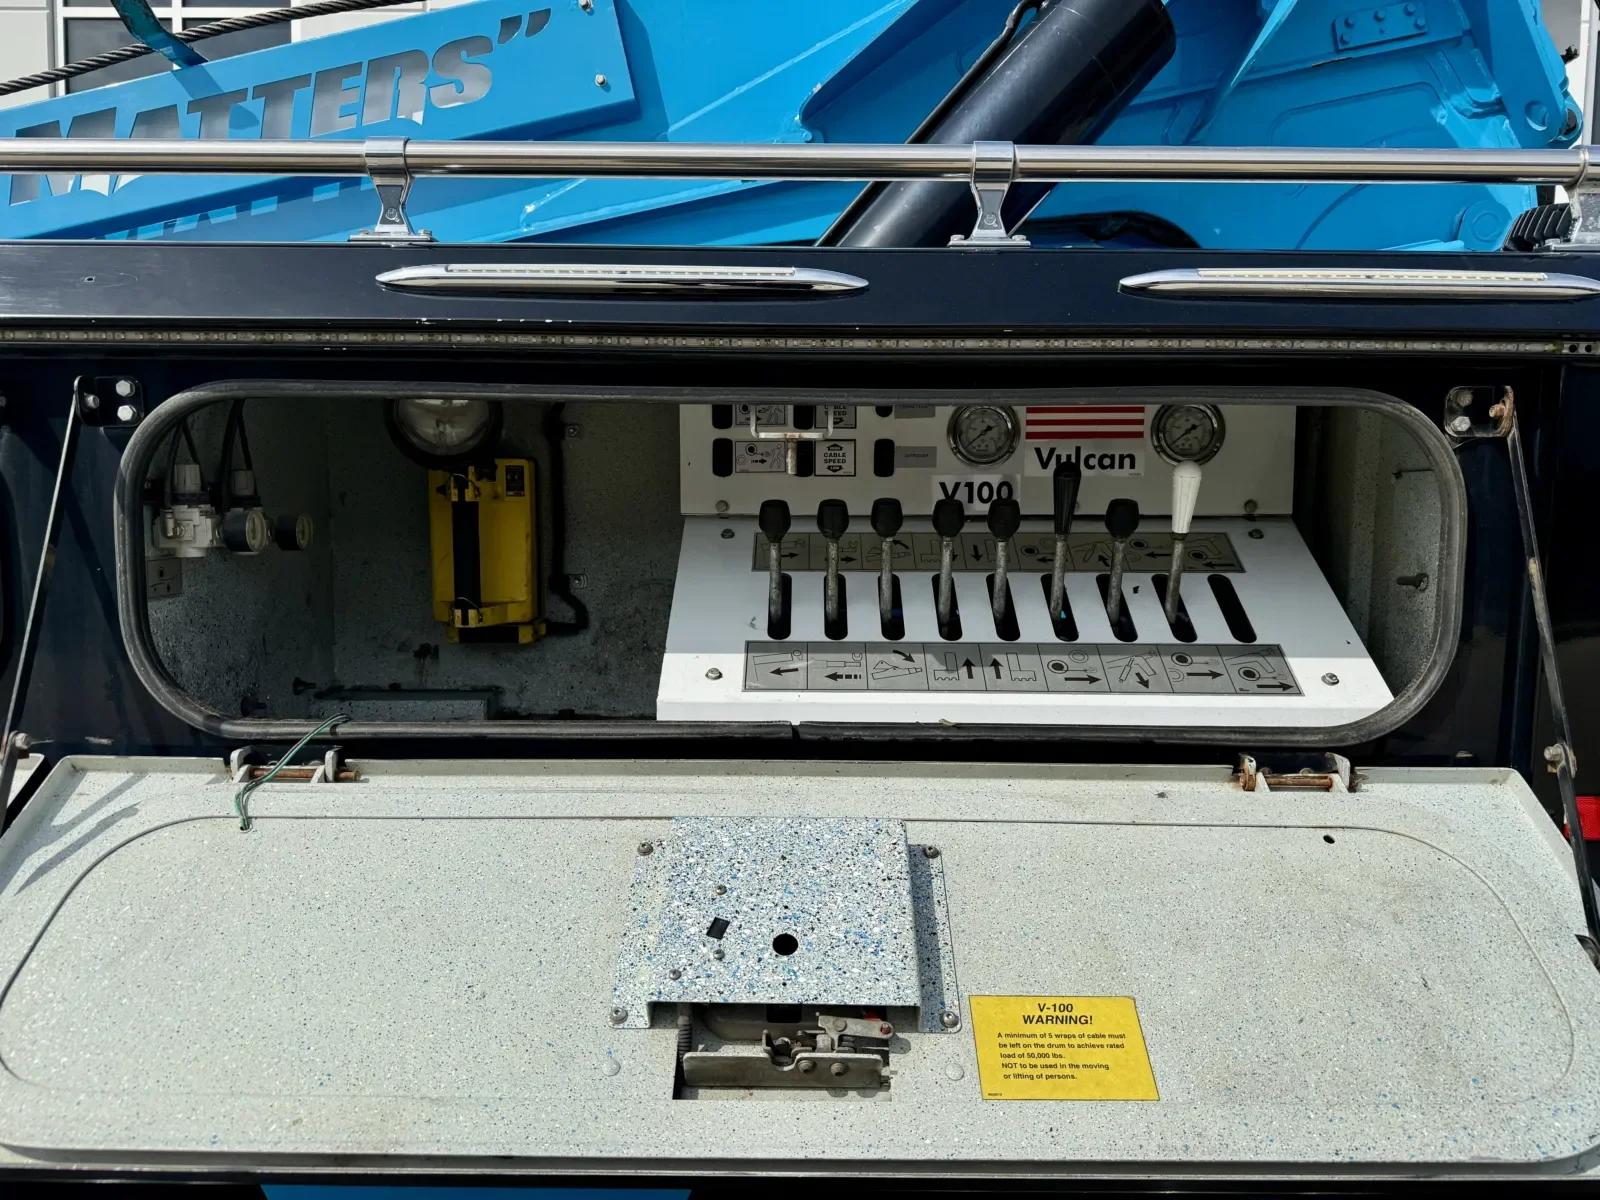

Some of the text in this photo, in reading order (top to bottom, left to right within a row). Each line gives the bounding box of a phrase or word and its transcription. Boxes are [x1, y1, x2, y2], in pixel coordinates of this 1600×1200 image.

[1034, 446, 1136, 470] Vulcan
[939, 481, 1013, 504] V100
[1037, 1002, 1074, 1013] V-100
[1022, 1014, 1093, 1025] WARNING!
[1026, 1052, 1051, 1060] 50,000
[1068, 1062, 1080, 1070] the
[1081, 1063, 1110, 1071] moving
[1012, 1072, 1035, 1081] lifting
